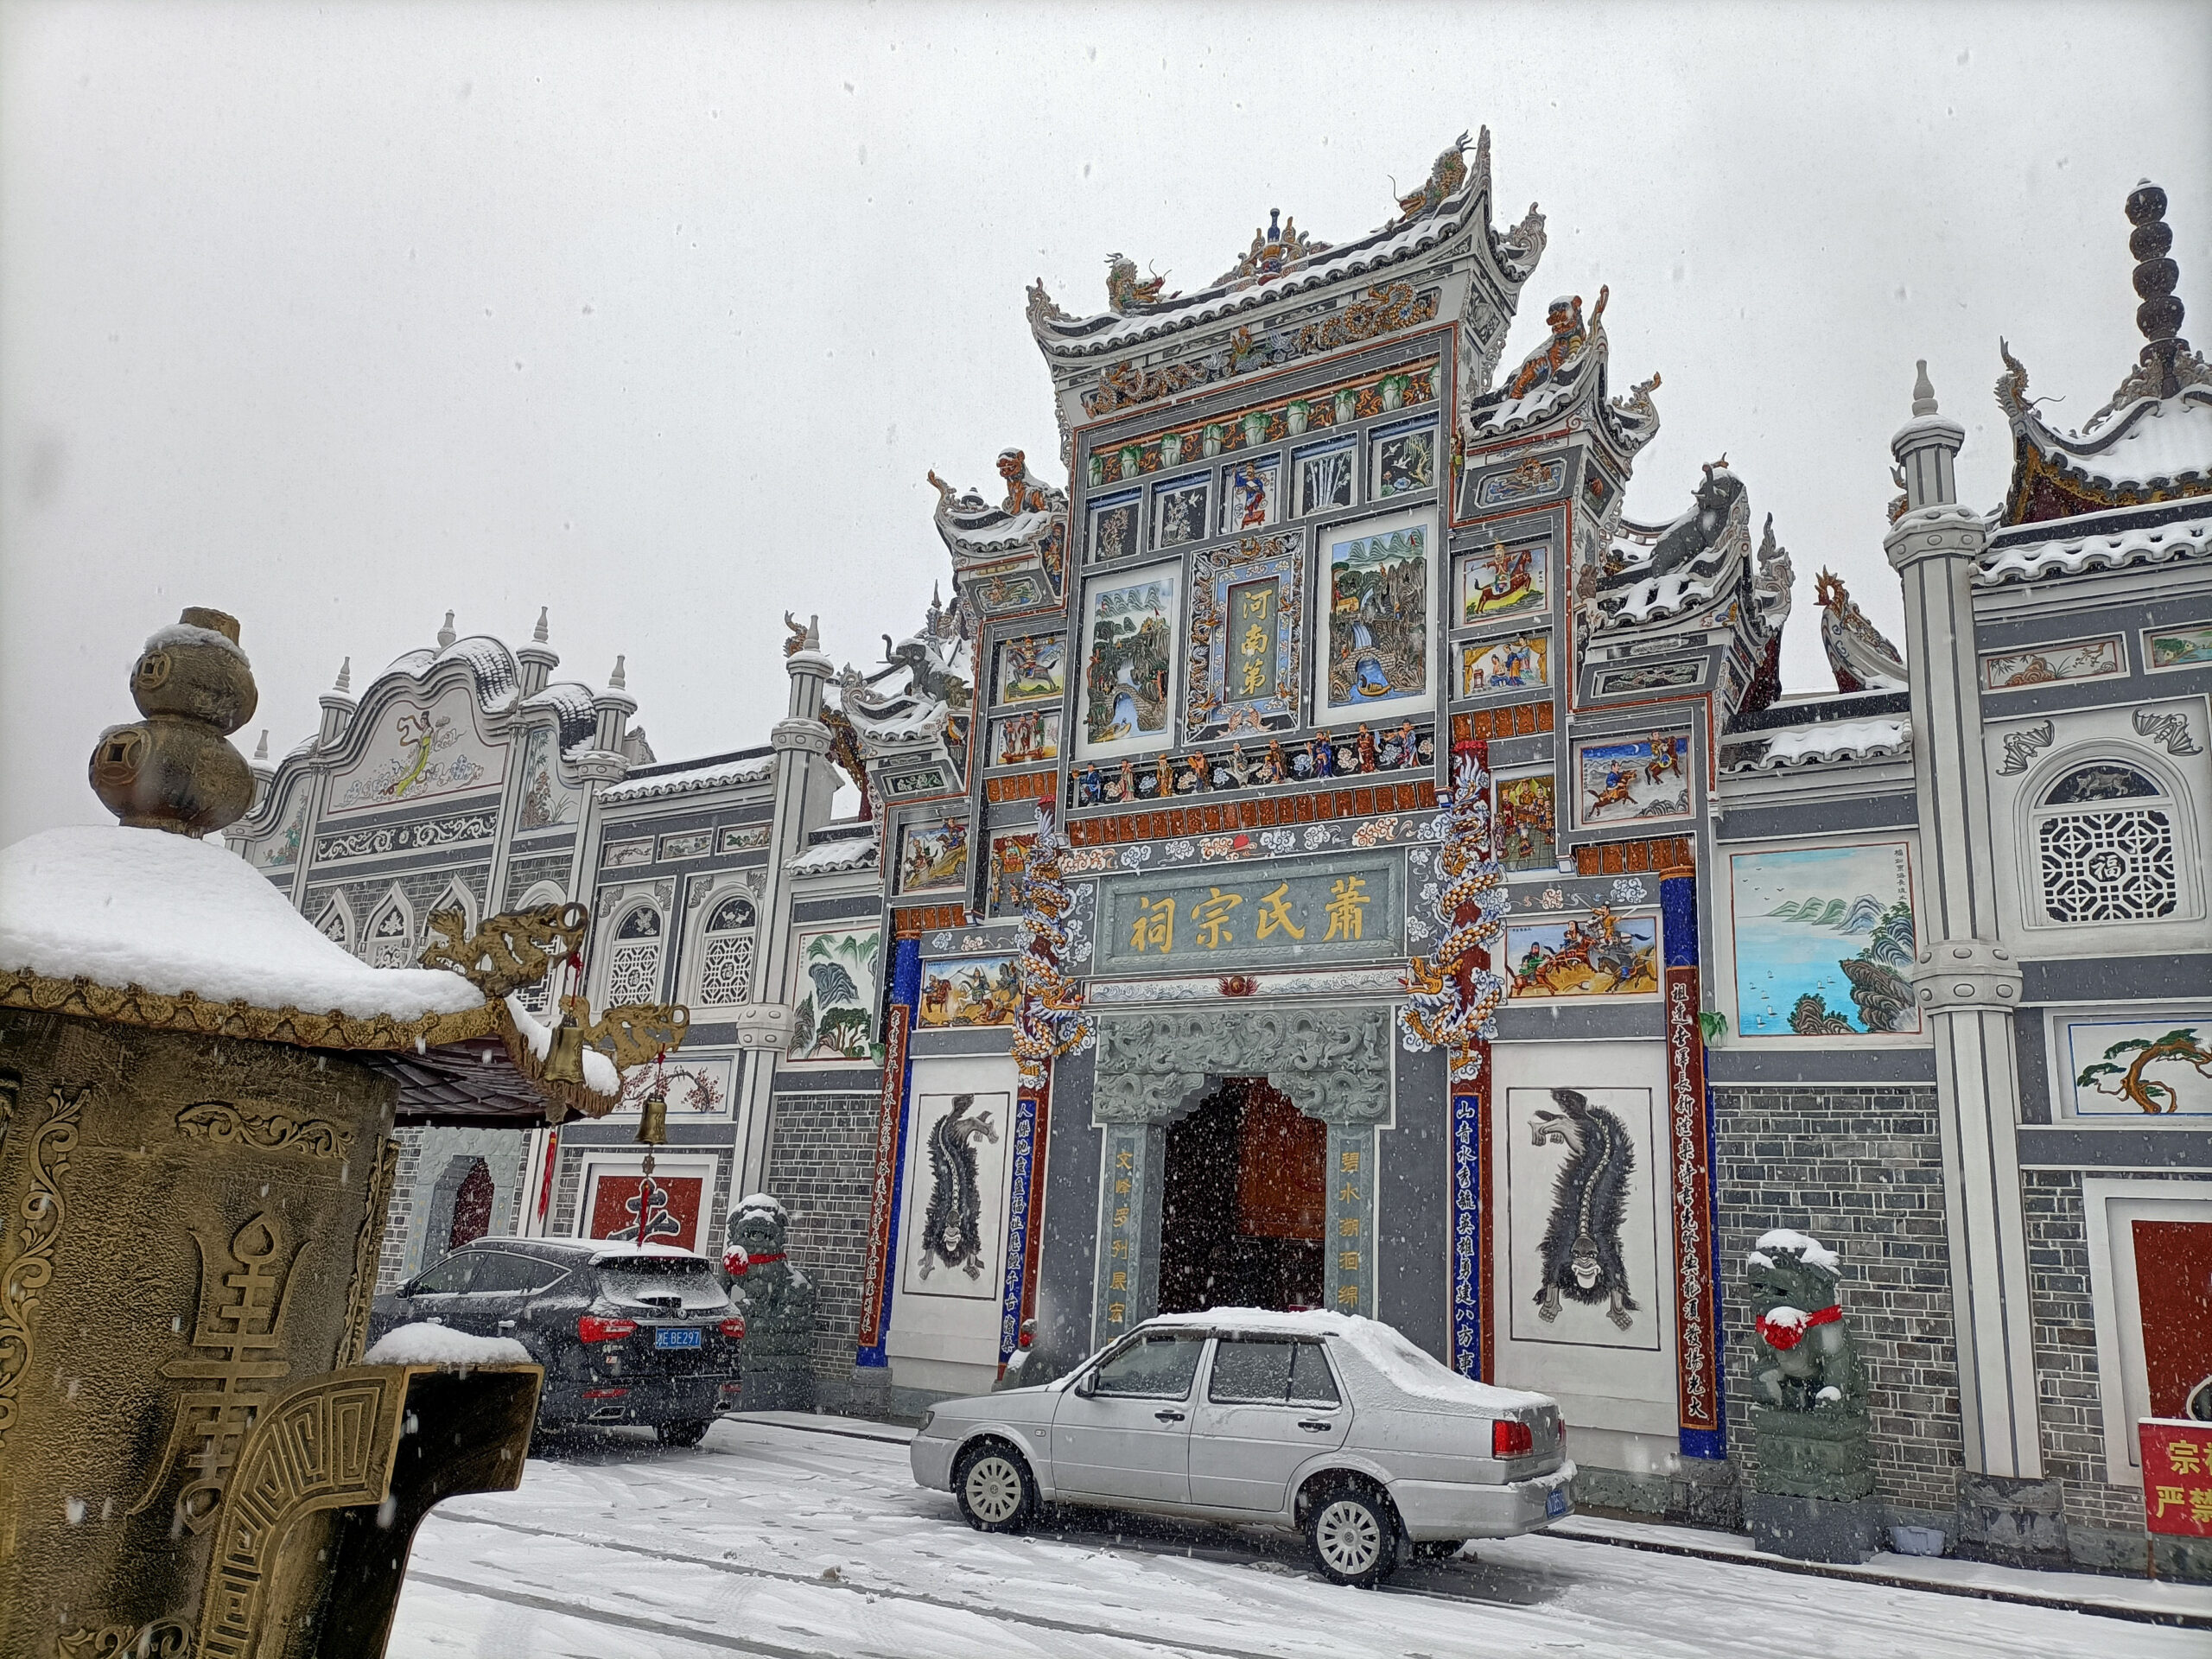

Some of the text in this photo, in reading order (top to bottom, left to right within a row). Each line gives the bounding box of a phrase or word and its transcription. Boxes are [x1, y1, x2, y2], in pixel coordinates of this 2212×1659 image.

[1240, 588, 1274, 695] 河南第
[1108, 1152, 1134, 1344] 文峰罗列展宏
[1455, 1101, 1478, 1380] 山青水秀毓英雄勇建八方事
